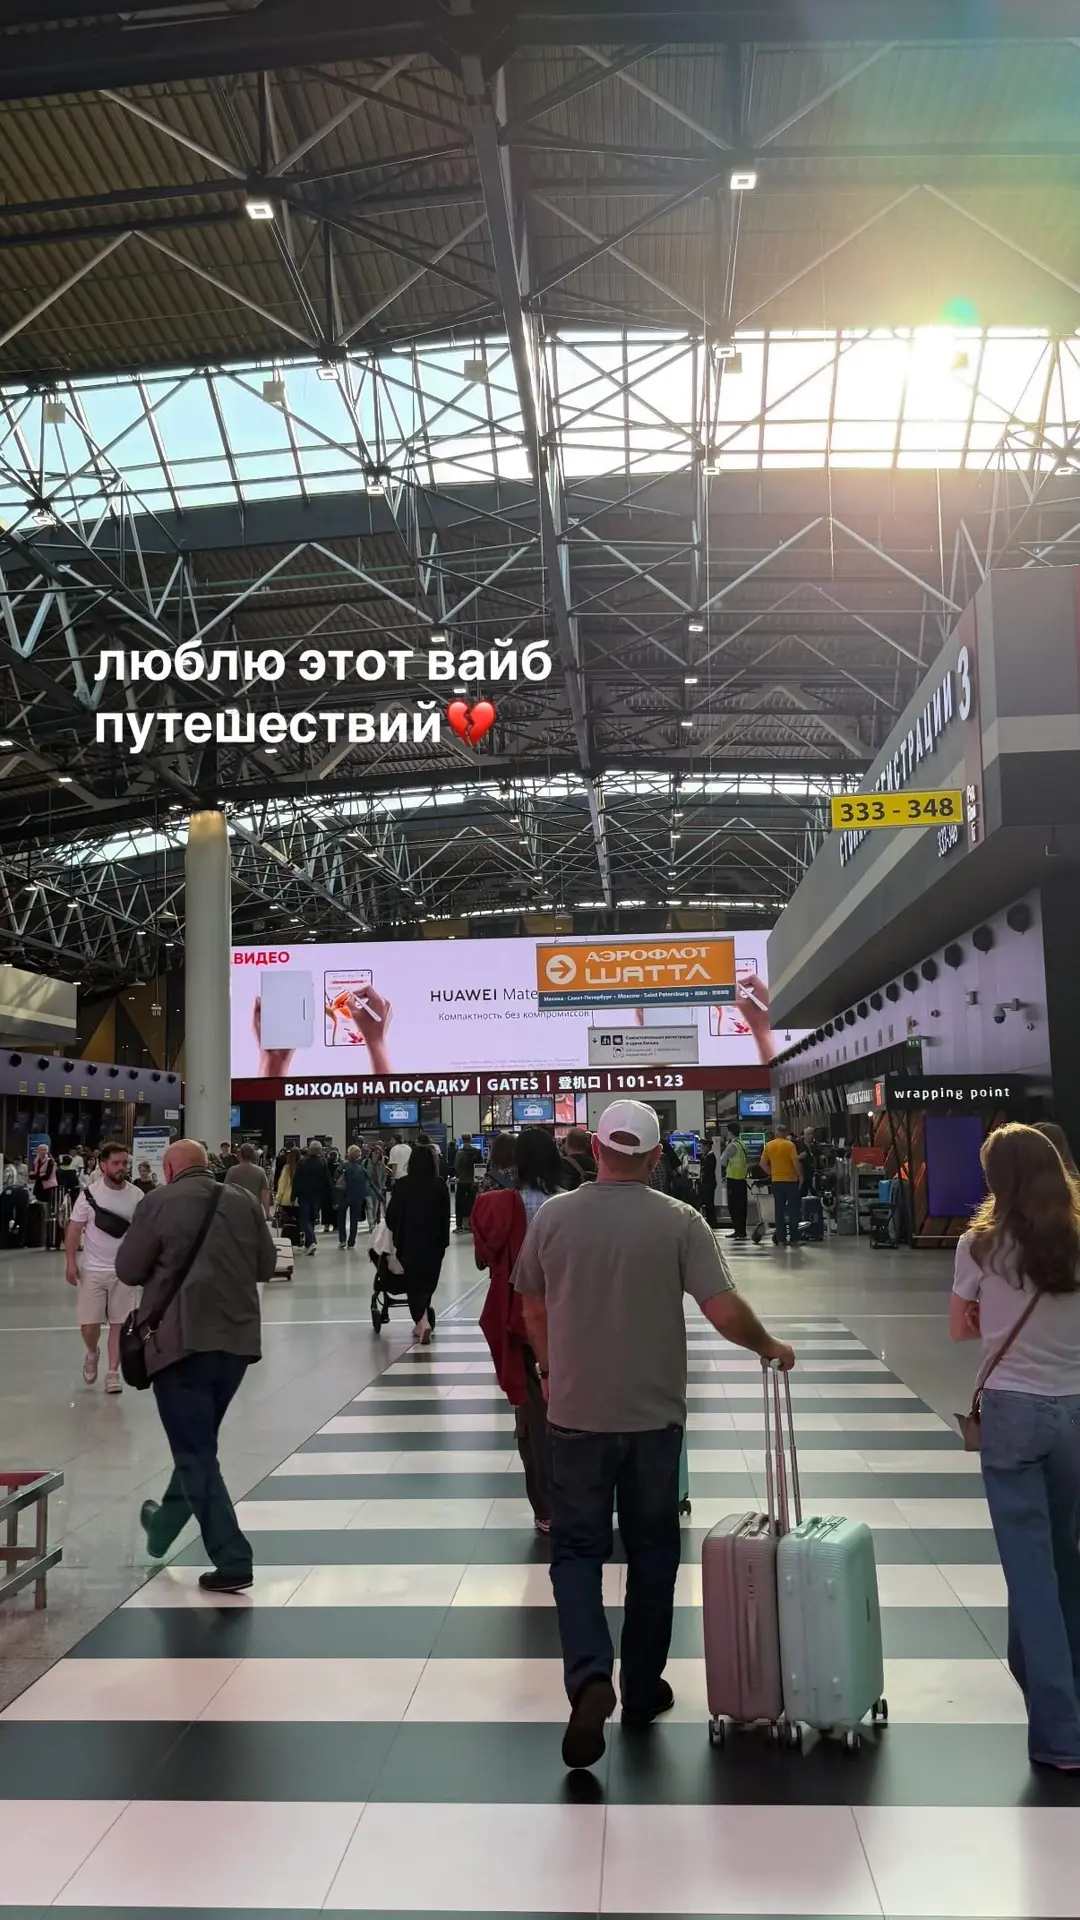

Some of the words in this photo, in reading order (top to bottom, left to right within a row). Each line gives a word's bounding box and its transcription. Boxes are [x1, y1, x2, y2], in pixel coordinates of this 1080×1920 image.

[957, 645, 971, 721] 3
[840, 802, 885, 822] 333
[907, 797, 954, 818] 348
[585, 946, 710, 963] АЭРОФЛОТ
[585, 963, 712, 984] ШАТТЛ
[430, 988, 497, 1002] HUAWEI
[503, 988, 538, 1001] Mate
[438, 1011, 502, 1021] Компактность
[505, 1009, 520, 1019] без
[523, 1010, 589, 1021] компромиссов
[284, 1081, 358, 1097] ВЫХОДЫ
[362, 1080, 385, 1094] НА
[389, 1078, 470, 1096] ПОСАДКУ
[487, 1077, 539, 1091] GATES
[558, 1075, 601, 1090] 登机口
[616, 1074, 684, 1088] 101-123
[894, 1087, 963, 1100] wrapping
[970, 1086, 1010, 1100] point
